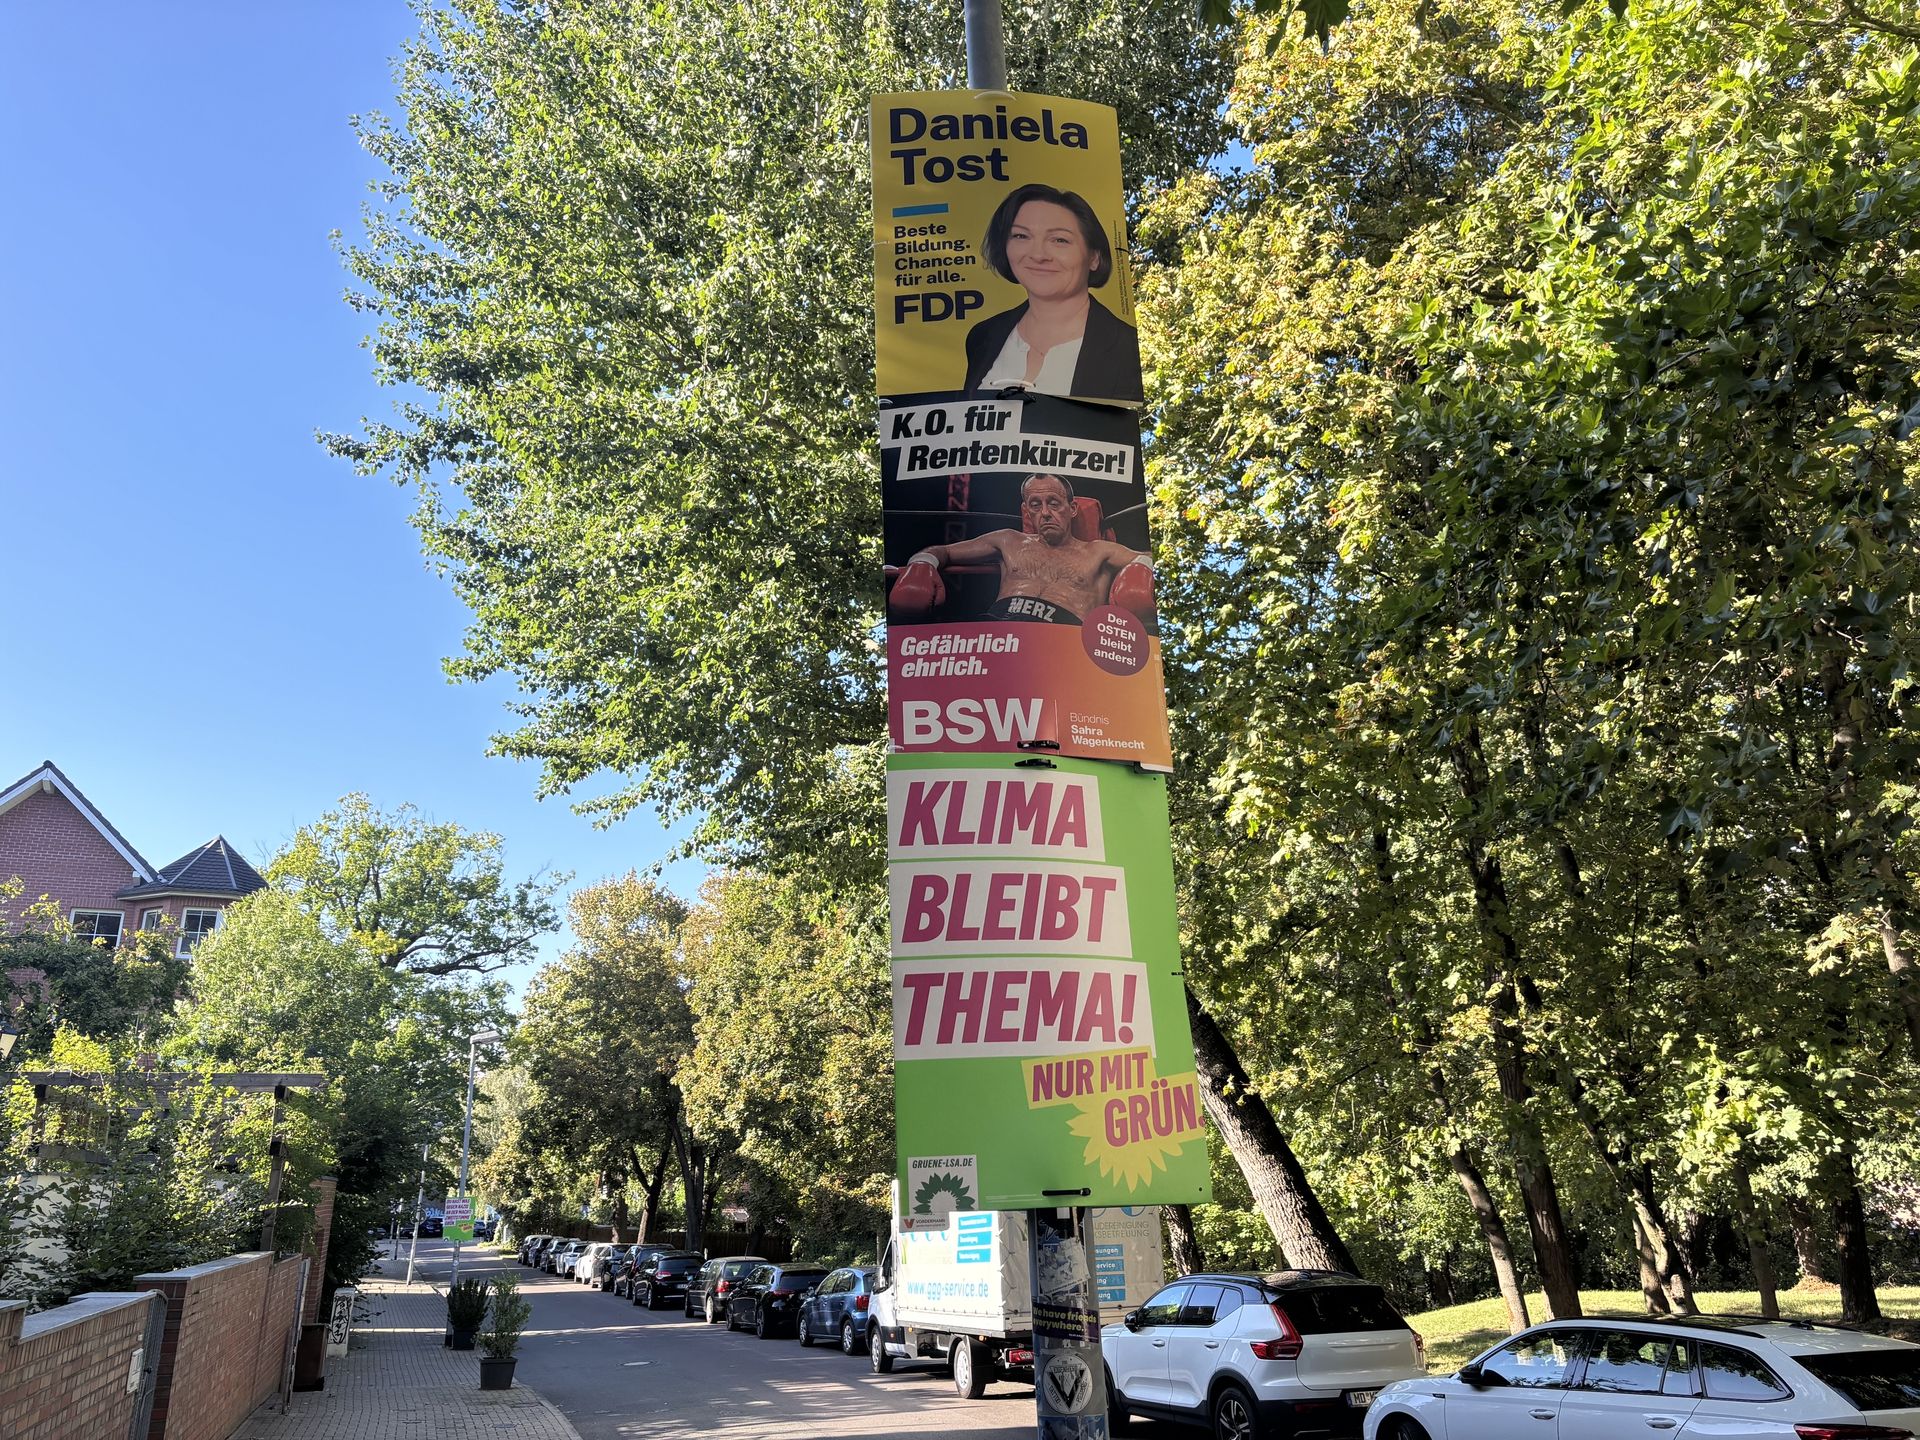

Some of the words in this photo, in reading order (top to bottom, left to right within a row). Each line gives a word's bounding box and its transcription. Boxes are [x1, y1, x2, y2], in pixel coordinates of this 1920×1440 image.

[889, 105, 1089, 149] Daniela
[890, 148, 1010, 185] Tost
[894, 223, 947, 239] Beste
[894, 238, 971, 255] Bildung.
[894, 254, 976, 271] Chancen
[894, 274, 922, 287] für
[926, 270, 966, 285] alle.
[894, 290, 985, 325] FDP
[891, 408, 954, 440] K.O.
[964, 404, 1012, 433] für
[906, 439, 1127, 475] Rentenkürzer!
[1008, 597, 1057, 623] MERZ
[1107, 613, 1128, 627] Der
[1097, 623, 1136, 642] OSTEN
[900, 633, 1019, 657] Gefährlich
[1100, 636, 1132, 653] bleibt
[901, 656, 988, 678] ehrlich.
[1094, 648, 1136, 666] anders!
[902, 698, 1043, 745] BSW
[1069, 712, 1110, 725] Bündnis
[1071, 724, 1103, 736] Sahra
[1072, 735, 1145, 750] Wagenknecht
[899, 781, 1088, 848] KLIMA
[901, 873, 1117, 943] BLEIBT
[902, 970, 1138, 1045] THEMA!
[1032, 1060, 1095, 1102] NUR
[1100, 1051, 1149, 1094] MIT
[1104, 1078, 1206, 1148] GRÜN.
[912, 1158, 974, 1168] GRUENE-LSA.DE
[1095, 1221, 1149, 1230] UDEREINIGUNG
[1095, 1230, 1150, 1238] SBETREUUNG
[907, 1278, 989, 1300] www.ggg-service.de
[1043, 1309, 1066, 1320] have
[1067, 1311, 1097, 1323] friends
